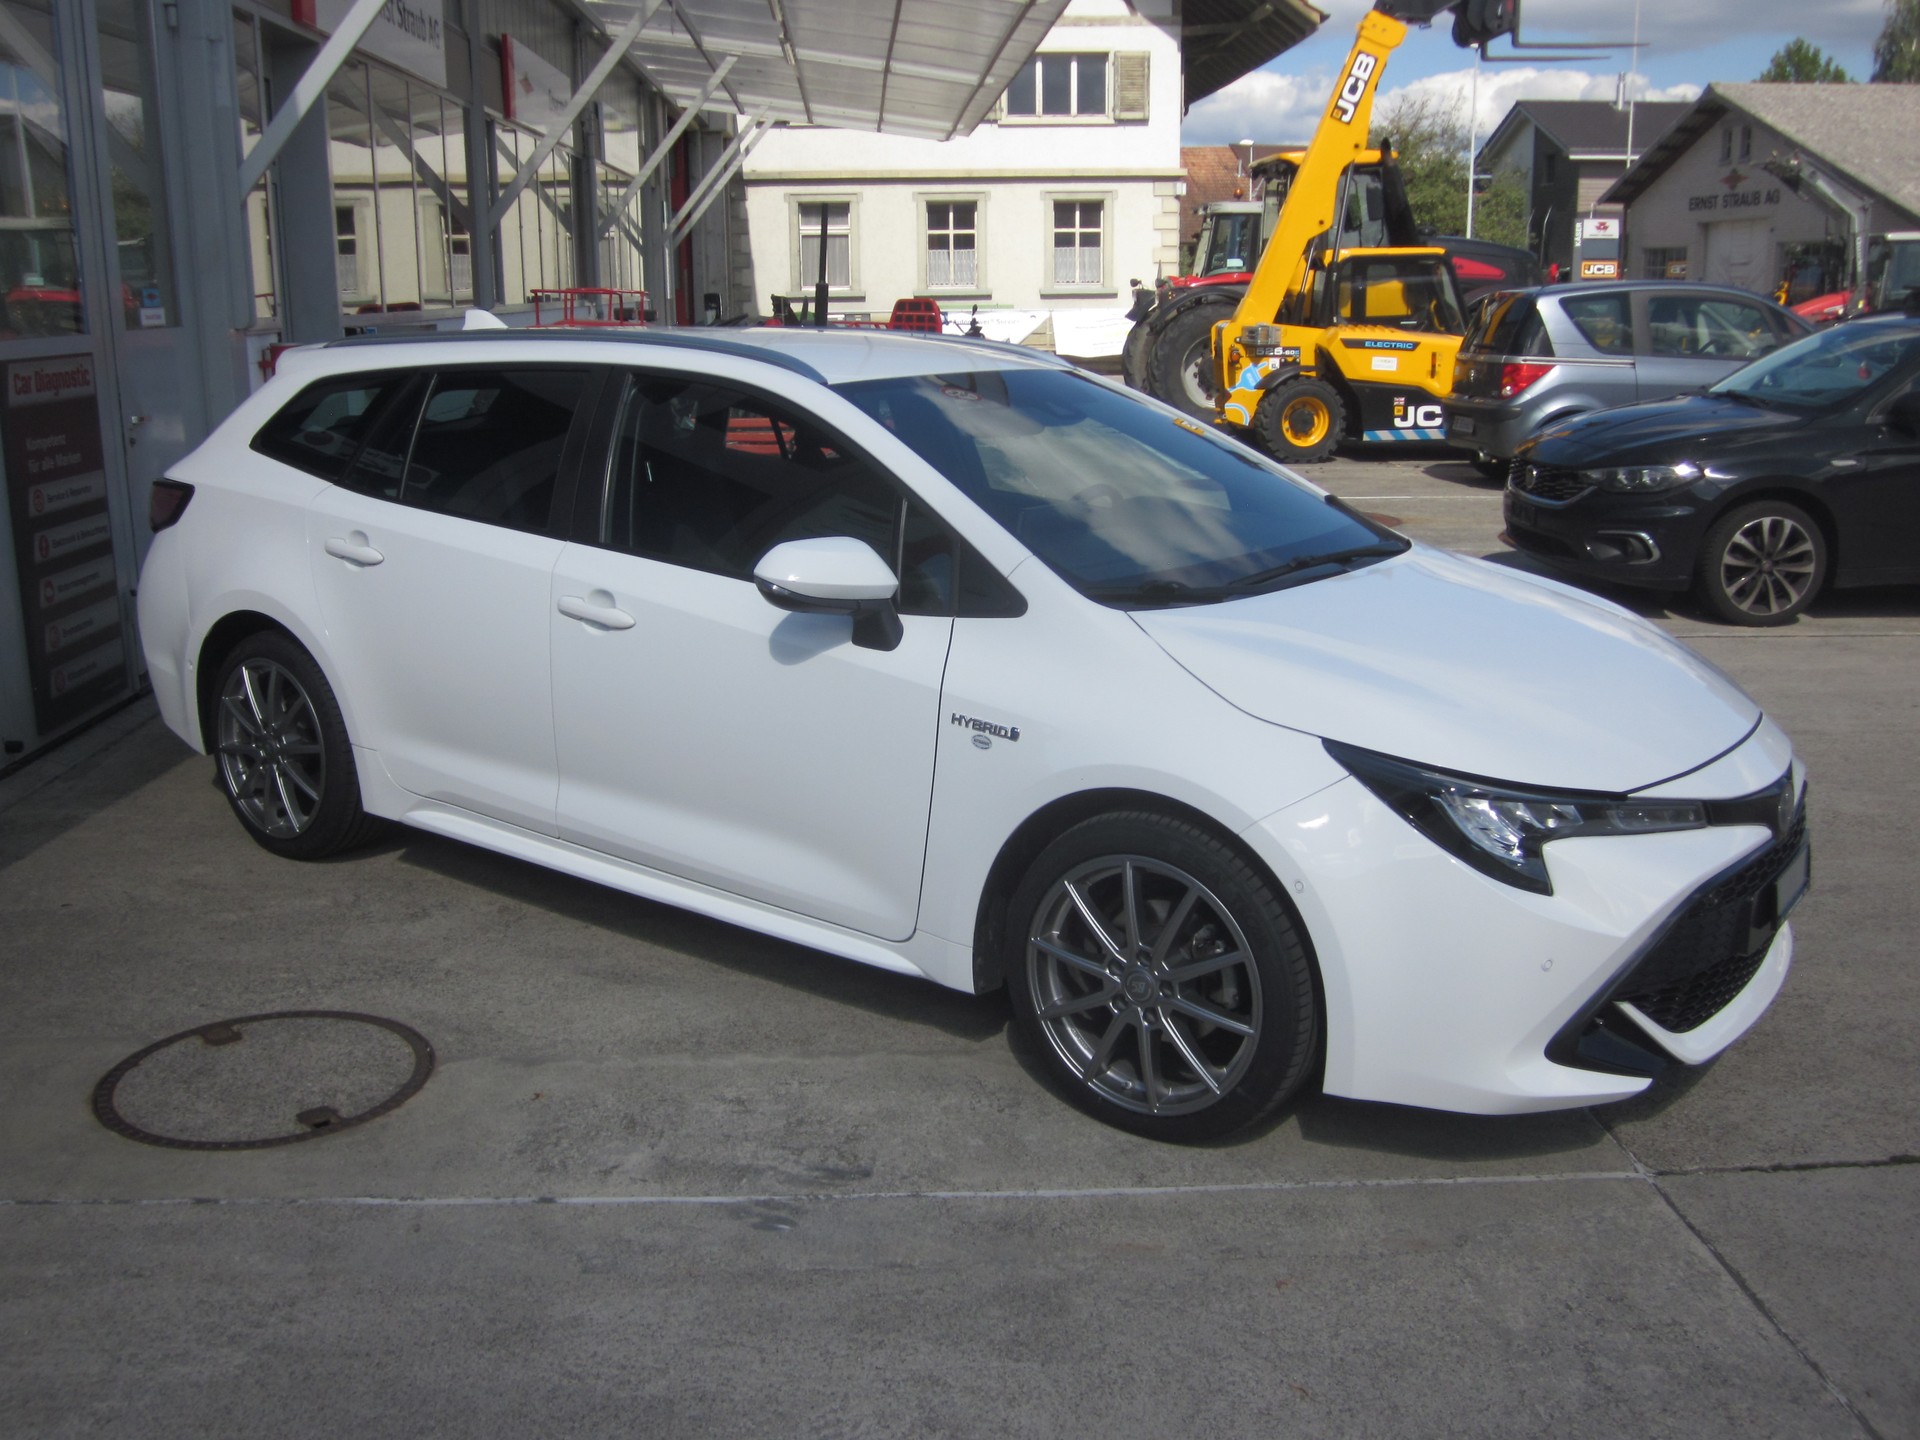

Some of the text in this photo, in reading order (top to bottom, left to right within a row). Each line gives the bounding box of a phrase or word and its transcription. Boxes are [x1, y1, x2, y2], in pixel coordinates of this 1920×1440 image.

[396, 0, 427, 43] Straub
[428, 15, 441, 50] AG
[1338, 52, 1377, 124] JCB
[1688, 188, 1780, 211] ERNST STRAUB AG
[1584, 264, 1615, 275] JCB
[1364, 340, 1414, 350] ELECTRIC
[14, 364, 91, 396] Car Diagnostic
[1393, 405, 1443, 428] JC
[951, 712, 1009, 739] HYBRID
